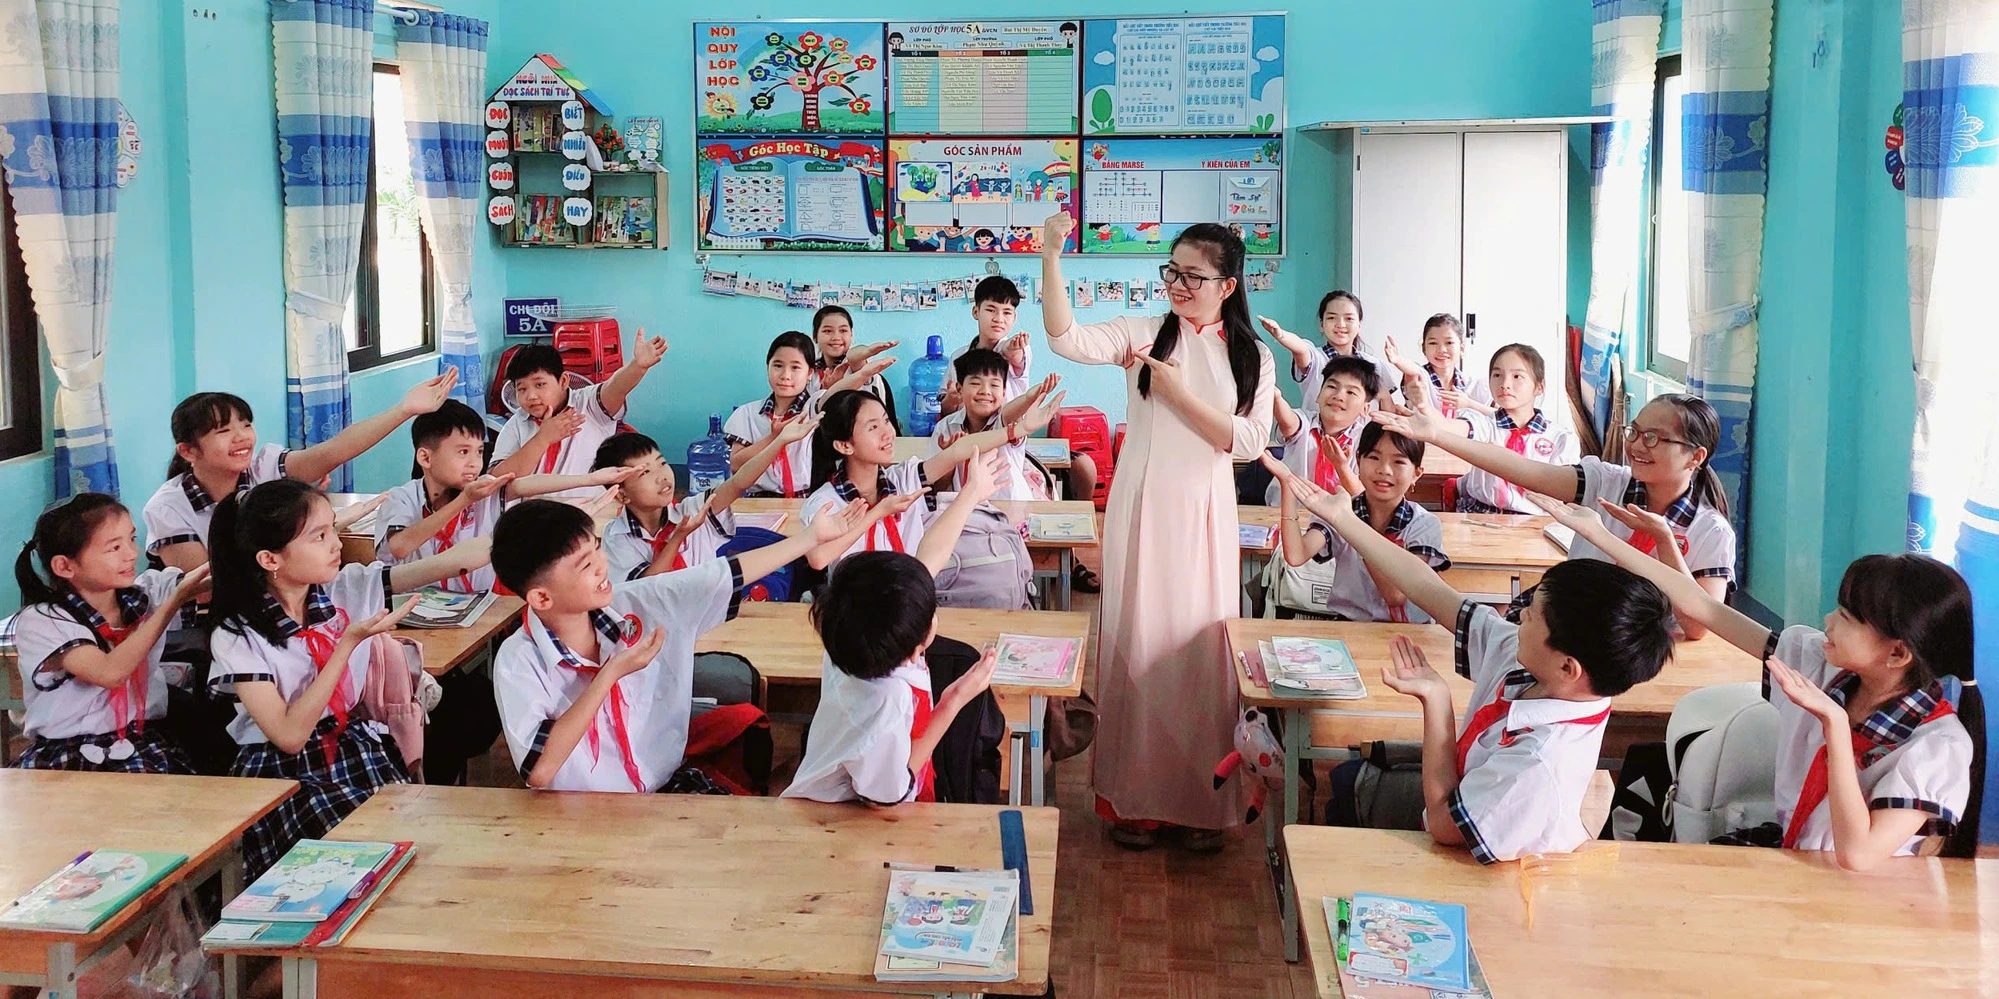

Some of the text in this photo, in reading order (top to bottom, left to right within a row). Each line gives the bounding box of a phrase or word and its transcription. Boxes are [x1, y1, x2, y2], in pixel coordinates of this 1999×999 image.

[710, 25, 736, 39] NỘI
[966, 24, 980, 34] 5A
[707, 43, 738, 54] QUY
[709, 58, 737, 70] LỚP
[516, 73, 537, 84] NGÔI
[707, 76, 739, 88] HỌC
[503, 87, 518, 98] ĐỌC
[520, 86, 539, 96] SÁCH
[541, 85, 554, 96] TRÍ
[489, 108, 508, 123] ĐỌC
[564, 104, 583, 119] BIẾT
[749, 142, 829, 158] Góc Học Tập
[944, 142, 1022, 156] GÓC SẢN PHẨM
[1102, 159, 1120, 168] BẢNG
[1207, 159, 1223, 168] KIẾN
[491, 202, 514, 218] SÁCH
[567, 205, 588, 217] HAY
[519, 317, 548, 332] 5A
